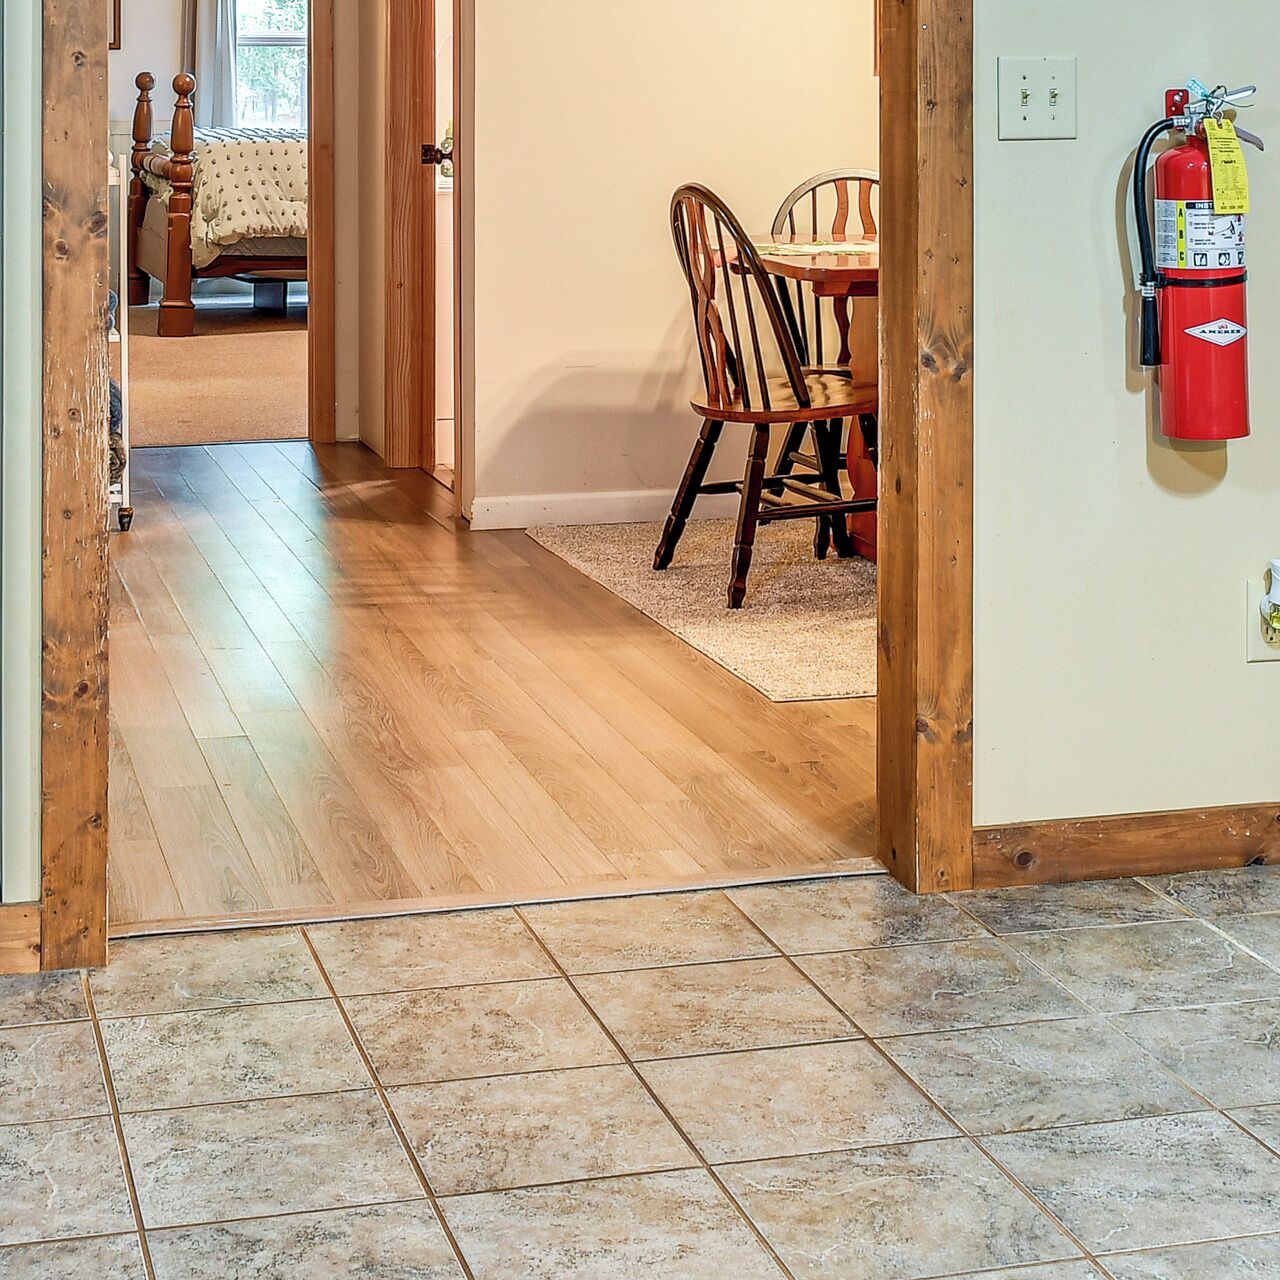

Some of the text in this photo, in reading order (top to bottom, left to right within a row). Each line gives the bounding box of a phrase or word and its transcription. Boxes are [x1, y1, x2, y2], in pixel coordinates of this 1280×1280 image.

[1178, 207, 1184, 218] A
[1179, 229, 1184, 239] B
[1179, 251, 1185, 261] C
